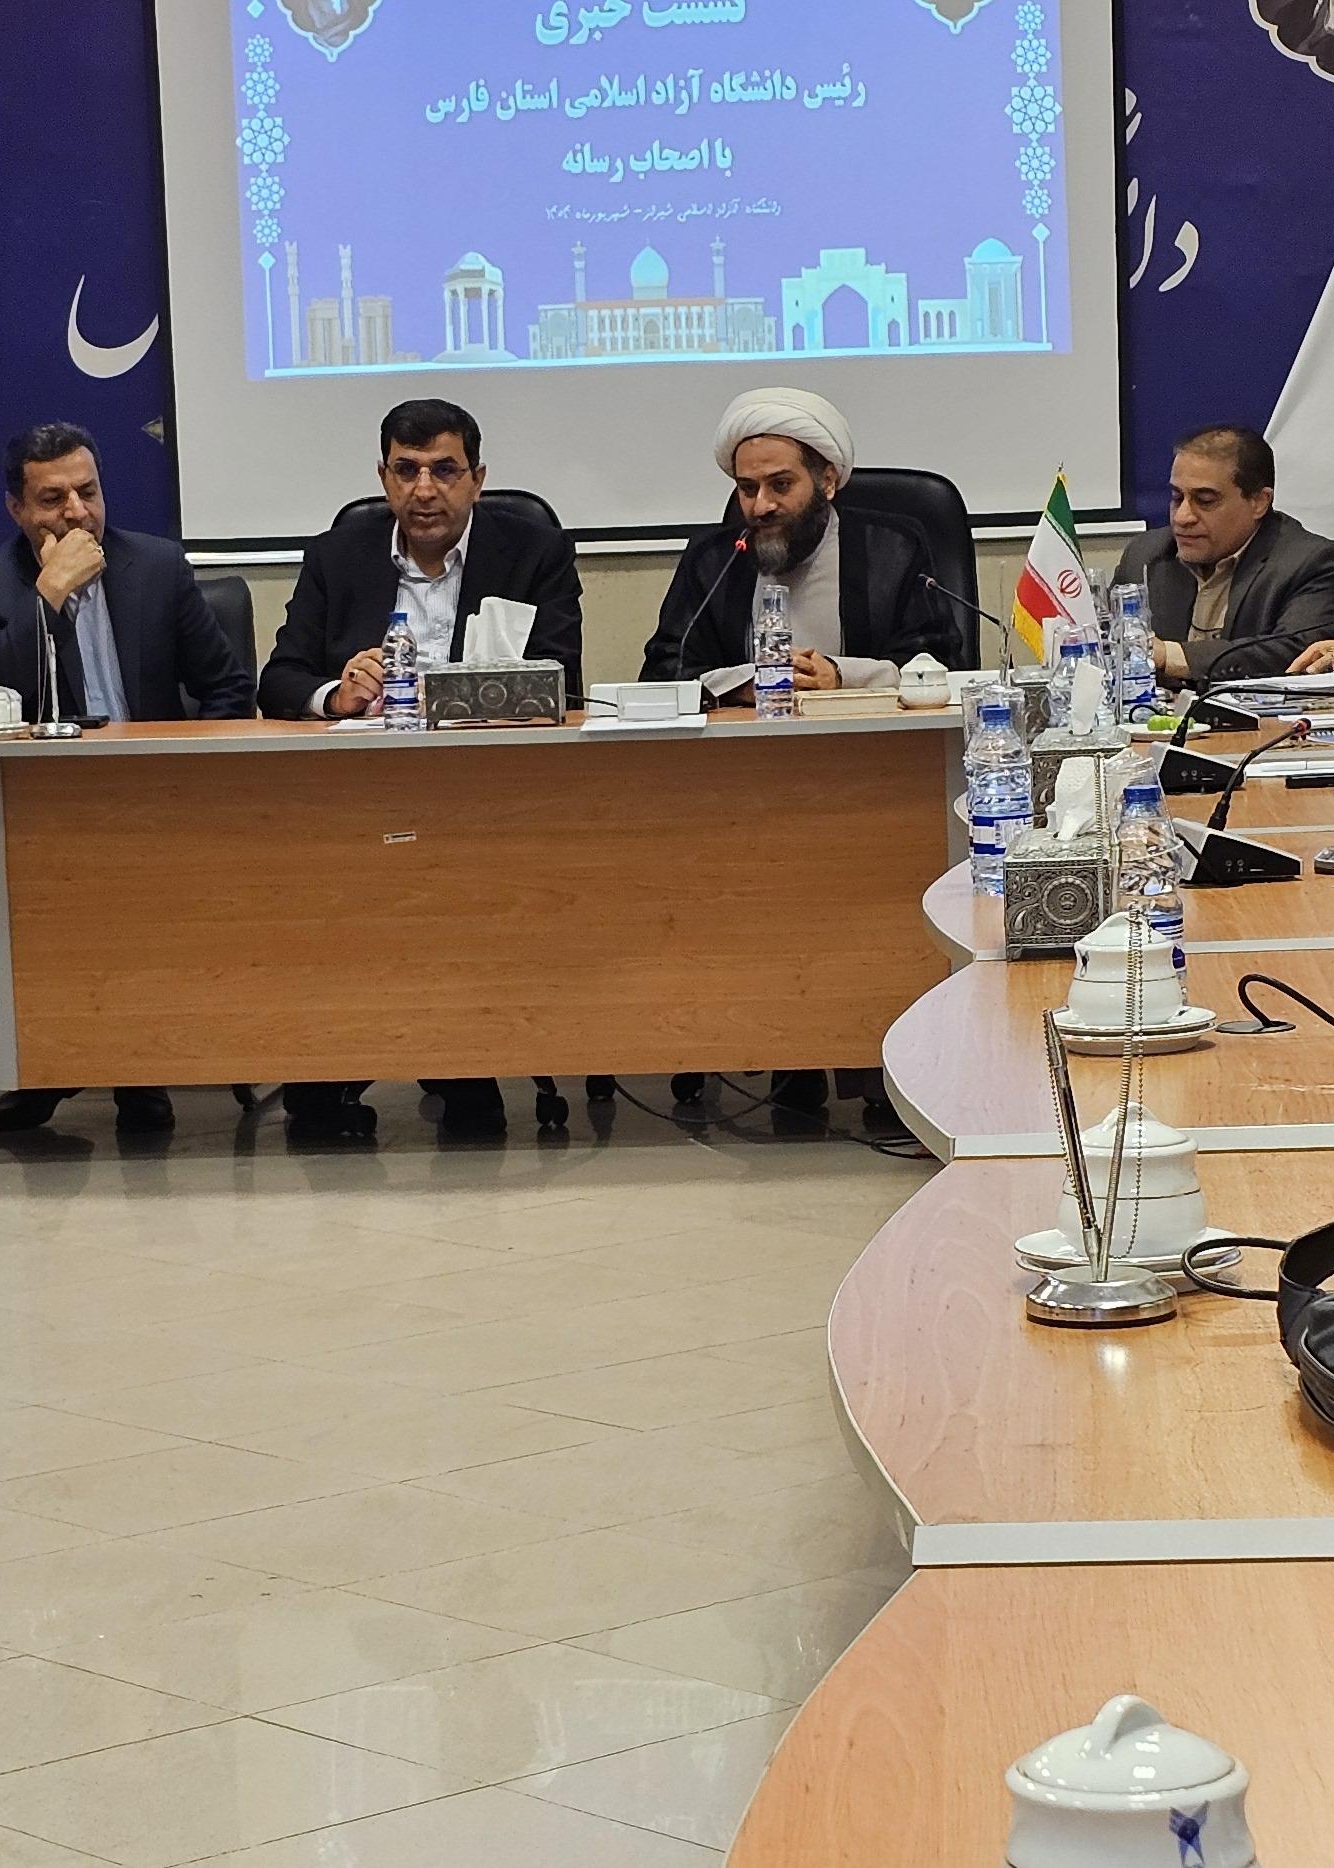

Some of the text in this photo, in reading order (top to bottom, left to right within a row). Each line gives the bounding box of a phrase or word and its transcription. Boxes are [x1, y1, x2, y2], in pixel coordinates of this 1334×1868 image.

[425, 62, 866, 123] رئیس دانشگاه آزاد اسلامی استان فارس
[562, 137, 733, 183] با اصحاب رسانه
